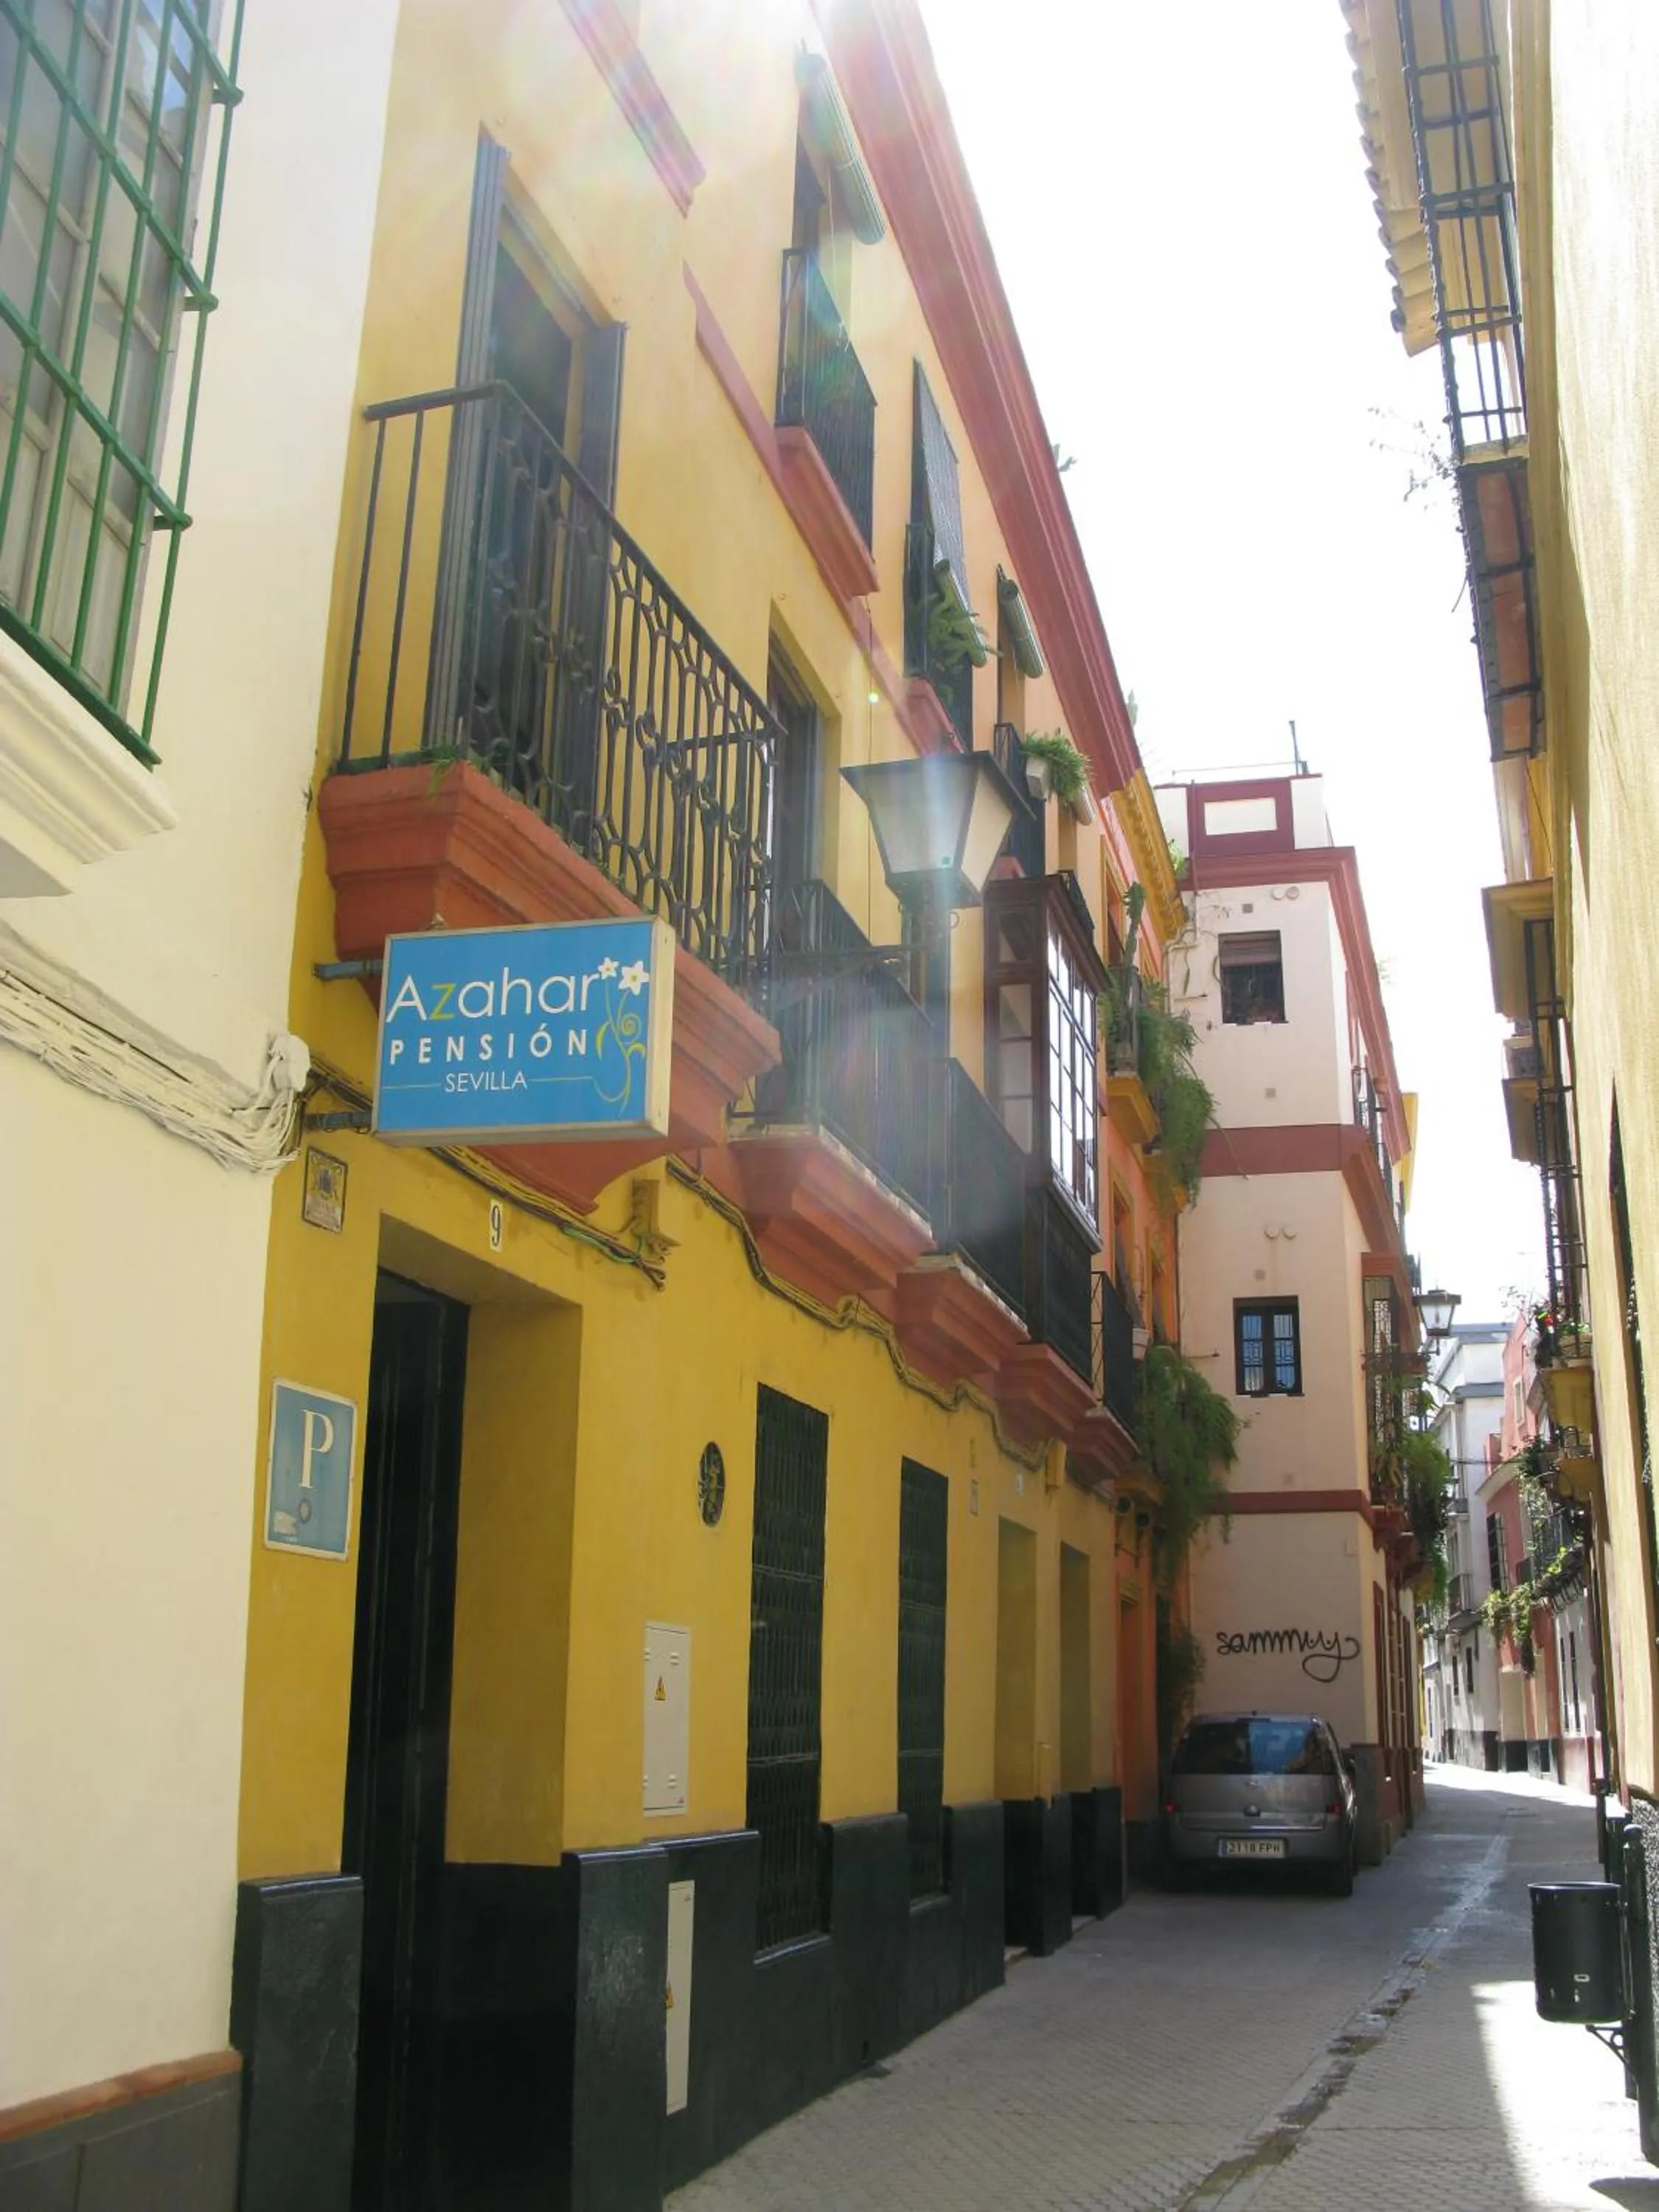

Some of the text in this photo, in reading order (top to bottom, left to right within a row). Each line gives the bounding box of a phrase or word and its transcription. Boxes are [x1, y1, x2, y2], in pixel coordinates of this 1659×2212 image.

[386, 967, 599, 1023] Azahar
[389, 1023, 587, 1065] PENSIÓN
[444, 1071, 528, 1093] SEVILLA
[490, 1205, 501, 1246] 9
[299, 1409, 334, 1488] P
